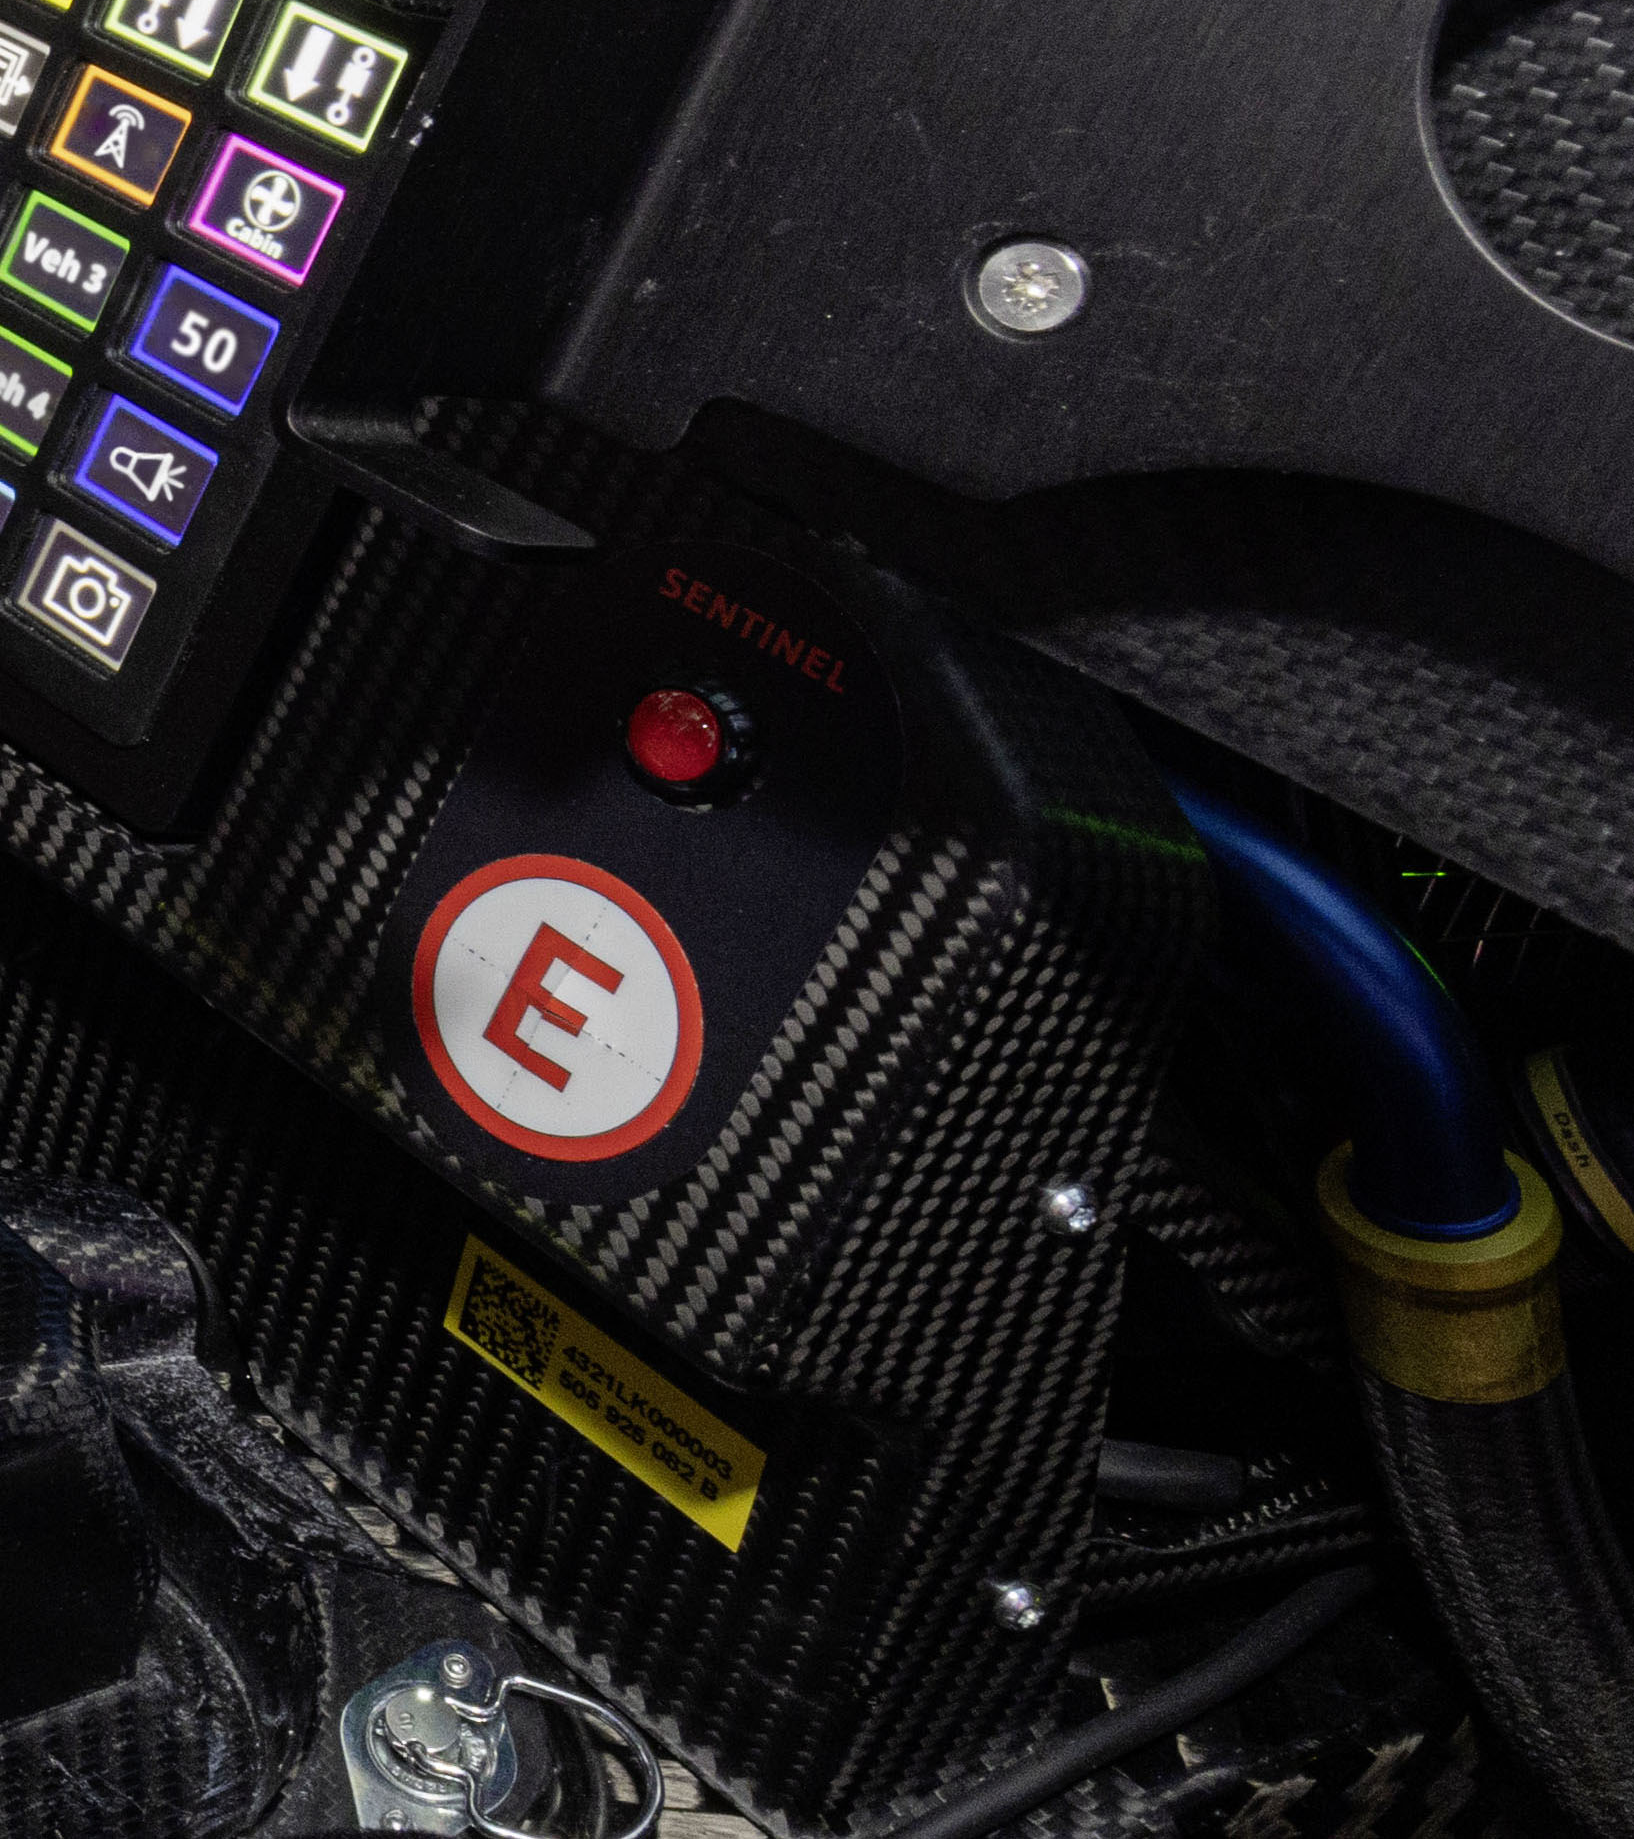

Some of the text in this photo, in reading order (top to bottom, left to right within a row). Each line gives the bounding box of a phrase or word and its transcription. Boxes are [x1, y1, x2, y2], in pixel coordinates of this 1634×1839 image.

[23, 237, 106, 294] Veh 3
[226, 219, 284, 261] Cabin
[171, 310, 237, 373] 50
[19, 390, 46, 420] 4
[659, 567, 845, 694] SENTINEL
[483, 921, 625, 1093] E
[1555, 1114, 1589, 1167] Dash
[559, 1369, 601, 1410] 505
[700, 1477, 718, 1501] B
